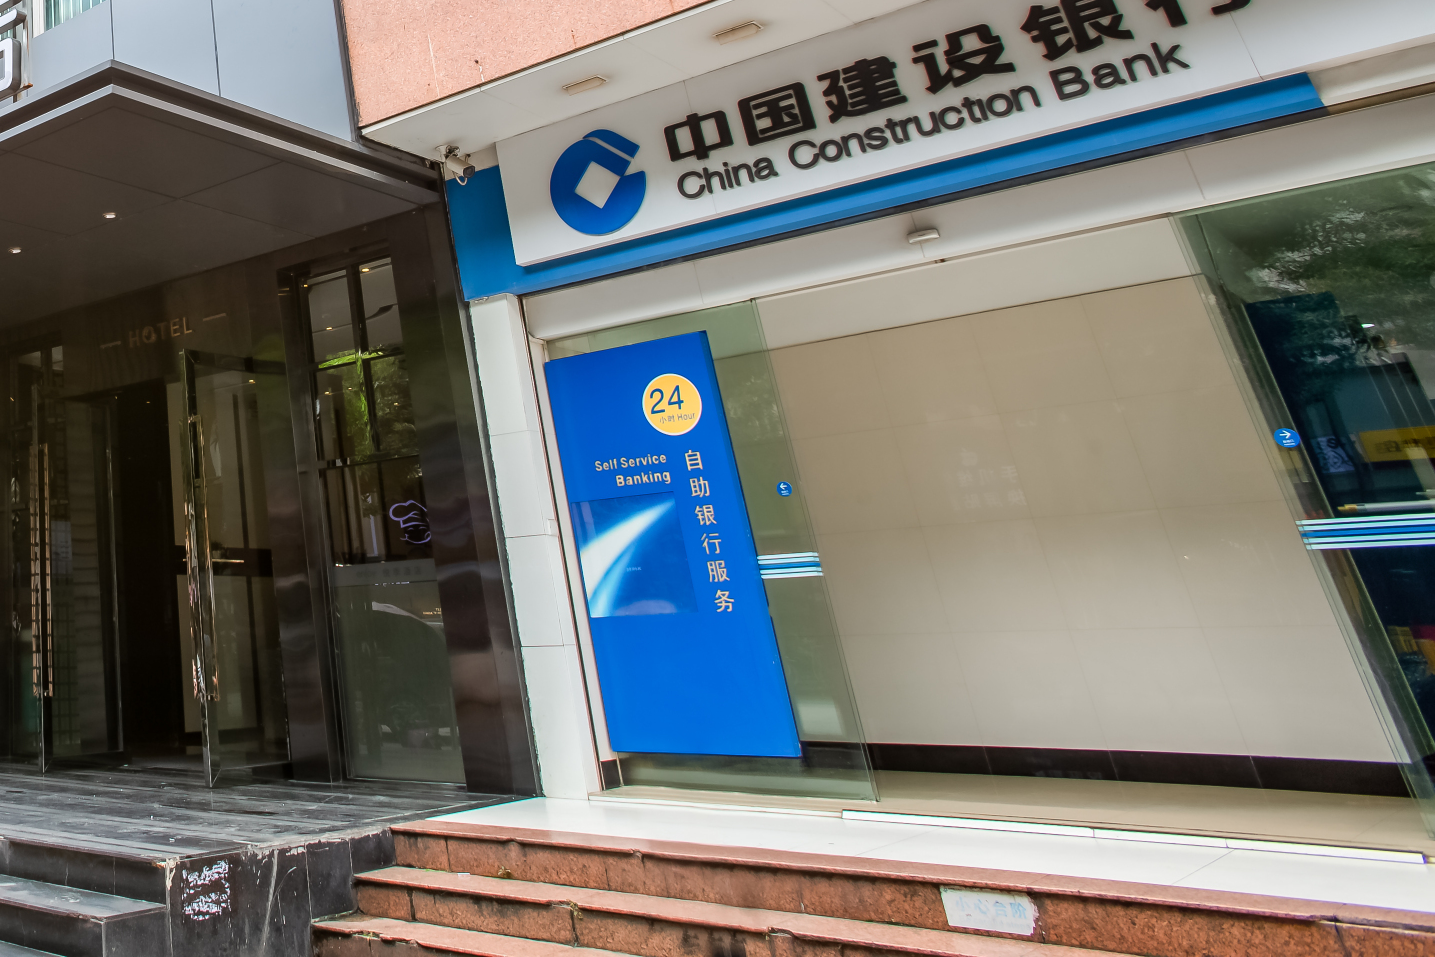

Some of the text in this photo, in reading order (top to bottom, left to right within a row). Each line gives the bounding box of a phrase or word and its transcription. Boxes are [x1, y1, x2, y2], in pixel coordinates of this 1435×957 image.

[676, 42, 1191, 199] China Construction Bank
[129, 317, 192, 347] HOTEL
[649, 385, 685, 414] 24
[677, 412, 696, 422] Hour
[594, 454, 667, 471] Self Service
[616, 471, 671, 487] Banking
[684, 449, 735, 613] 自助银行服务
